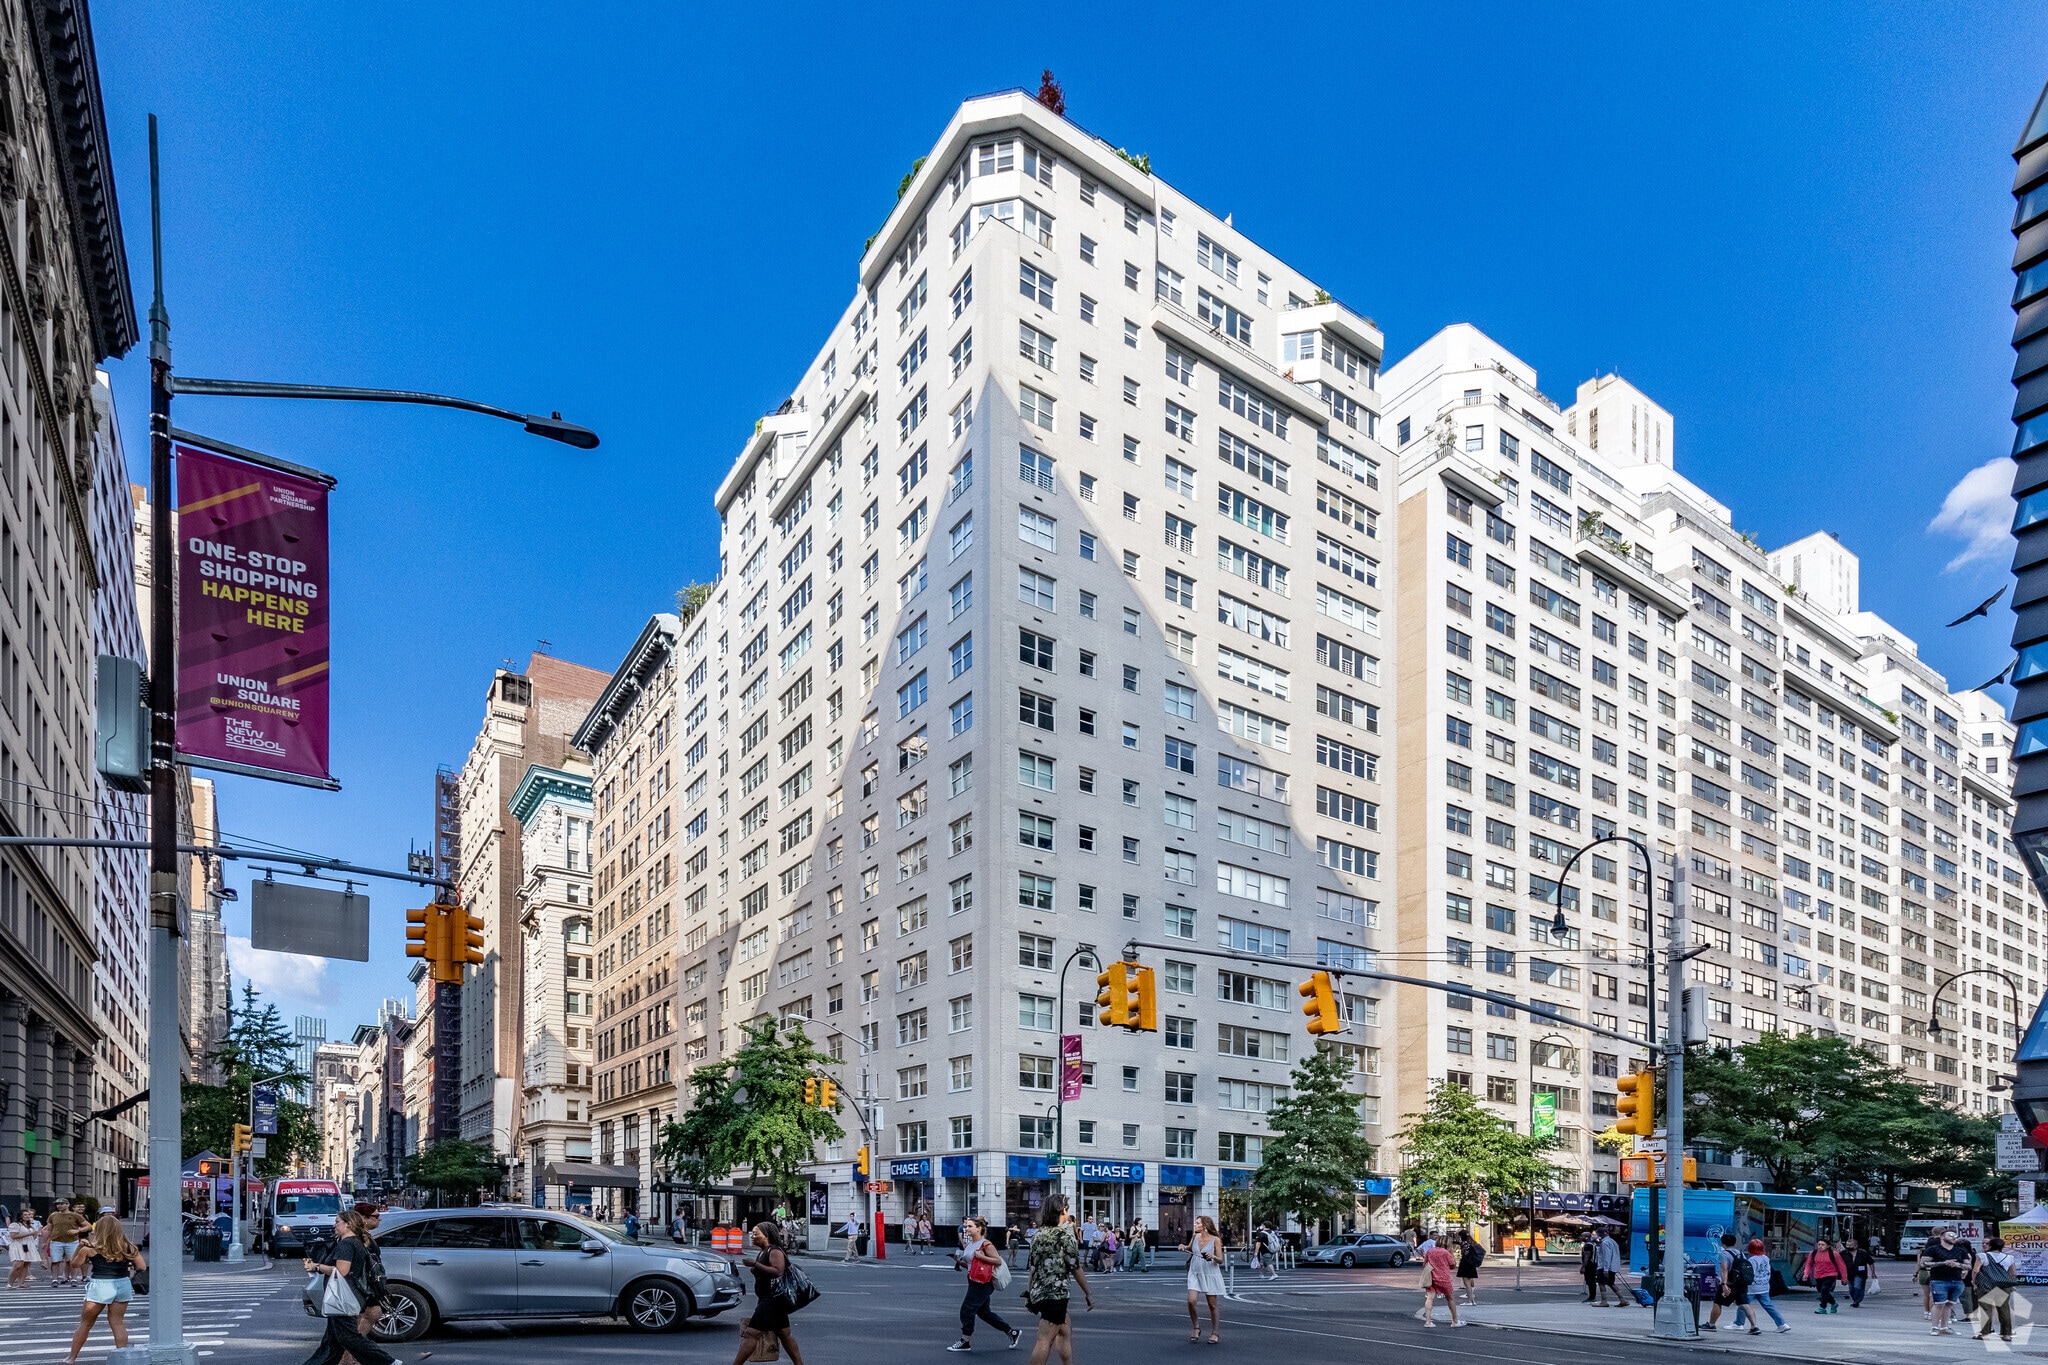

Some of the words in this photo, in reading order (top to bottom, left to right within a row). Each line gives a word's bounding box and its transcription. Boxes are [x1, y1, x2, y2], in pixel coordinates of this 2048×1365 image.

[273, 486, 295, 496] UNION
[281, 493, 307, 505] SQUARE
[269, 496, 316, 511] PARTNERSHIP
[189, 537, 307, 576] ONE-STOP
[200, 560, 318, 598] SHOPPING
[202, 580, 309, 616] HAPPENS
[247, 609, 304, 634] HERE
[217, 672, 268, 692] UNION
[210, 696, 300, 719] @UNIONSQUARENY
[237, 689, 300, 710] SQUARE
[224, 716, 252, 728] THE
[226, 725, 264, 738] NEW
[225, 733, 286, 751] SCHOOL
[891, 1163, 920, 1176] CHASE
[1081, 1164, 1130, 1178] CHASE
[1958, 1222, 1979, 1238] FedEx
